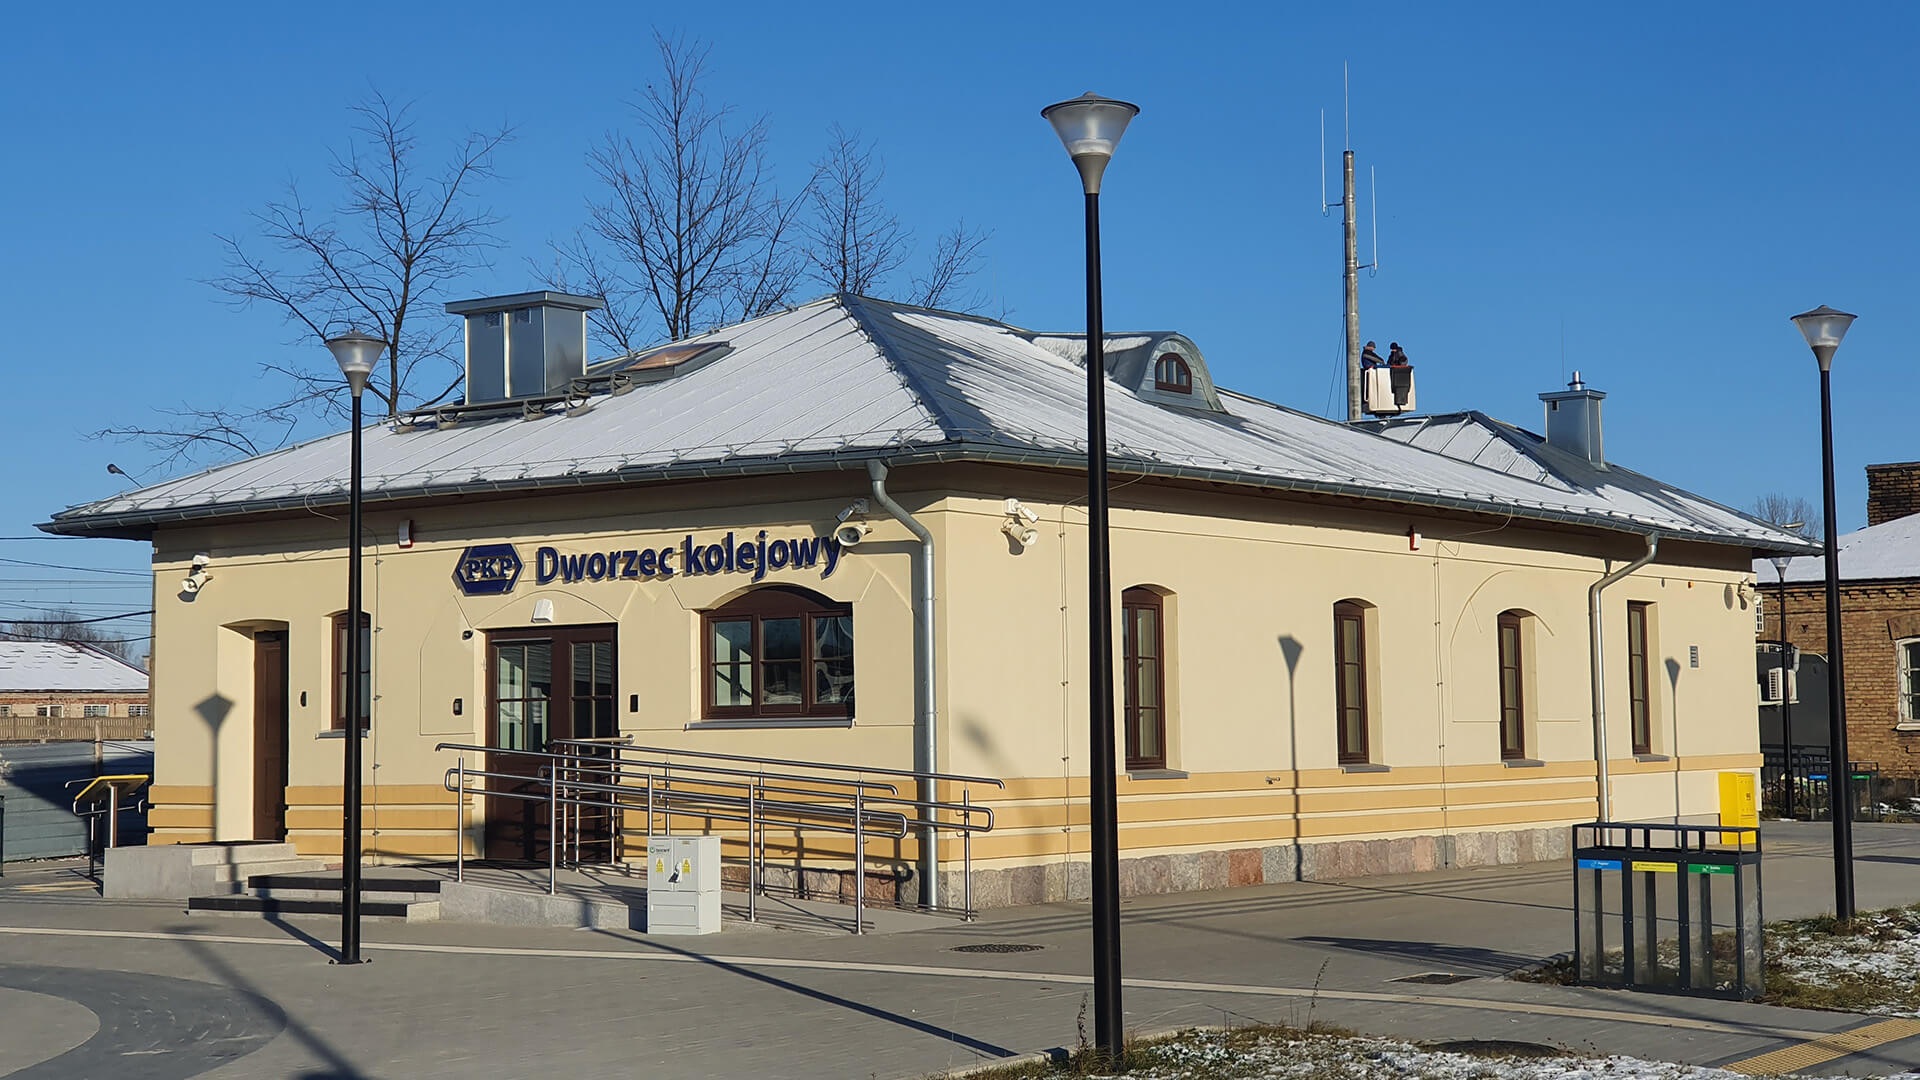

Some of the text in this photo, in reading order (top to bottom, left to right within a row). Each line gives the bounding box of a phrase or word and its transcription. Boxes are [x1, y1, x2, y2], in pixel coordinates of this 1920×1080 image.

[465, 530, 841, 586] PKP Dworzec kolejowy
